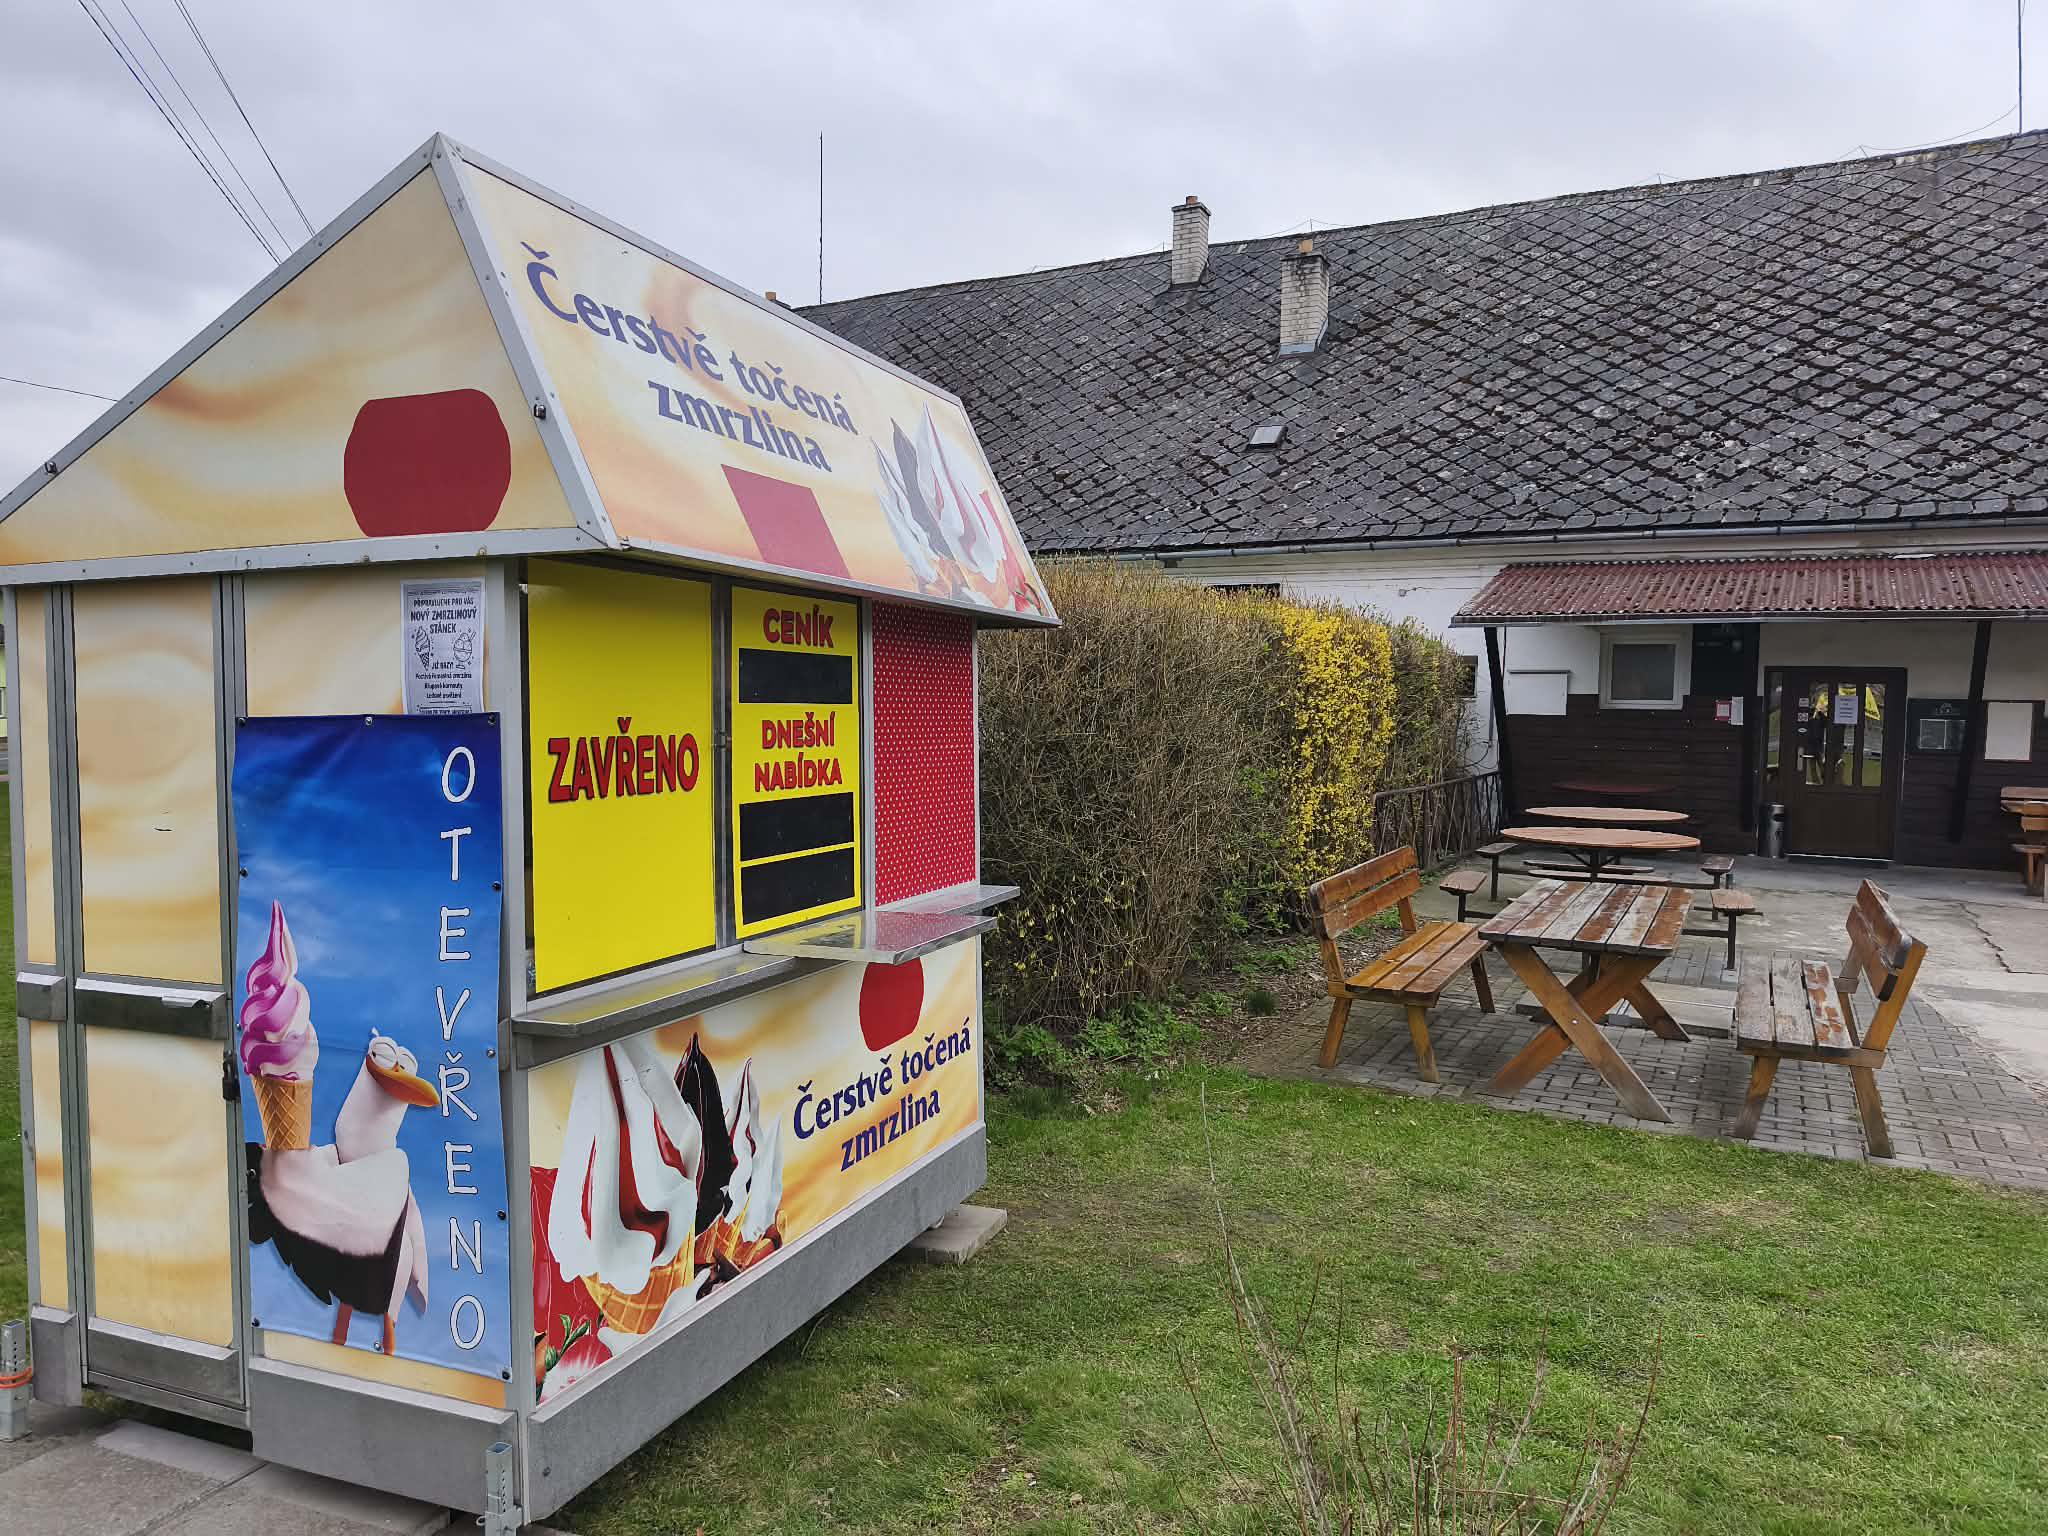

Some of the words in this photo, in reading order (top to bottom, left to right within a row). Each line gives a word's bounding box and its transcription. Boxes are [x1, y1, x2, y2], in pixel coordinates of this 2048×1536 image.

[520, 241, 724, 381] Čerstvě
[729, 351, 859, 435] točená
[648, 380, 833, 473] zmrzlina
[410, 608, 430, 621] NOVÝ
[432, 606, 477, 620] ZMRZLINOVÝ
[429, 621, 456, 634] STÁNEK
[763, 604, 834, 648] CENÍK
[548, 716, 700, 804] ZAVŘENO
[762, 711, 836, 749] DNEŠNÍ
[754, 752, 842, 793] NABÍDKA
[435, 746, 487, 1351] OTEVŘENO
[793, 1054, 893, 1140] Čerstvě
[900, 1016, 971, 1085] točená
[840, 1089, 941, 1172] zmrzlina
